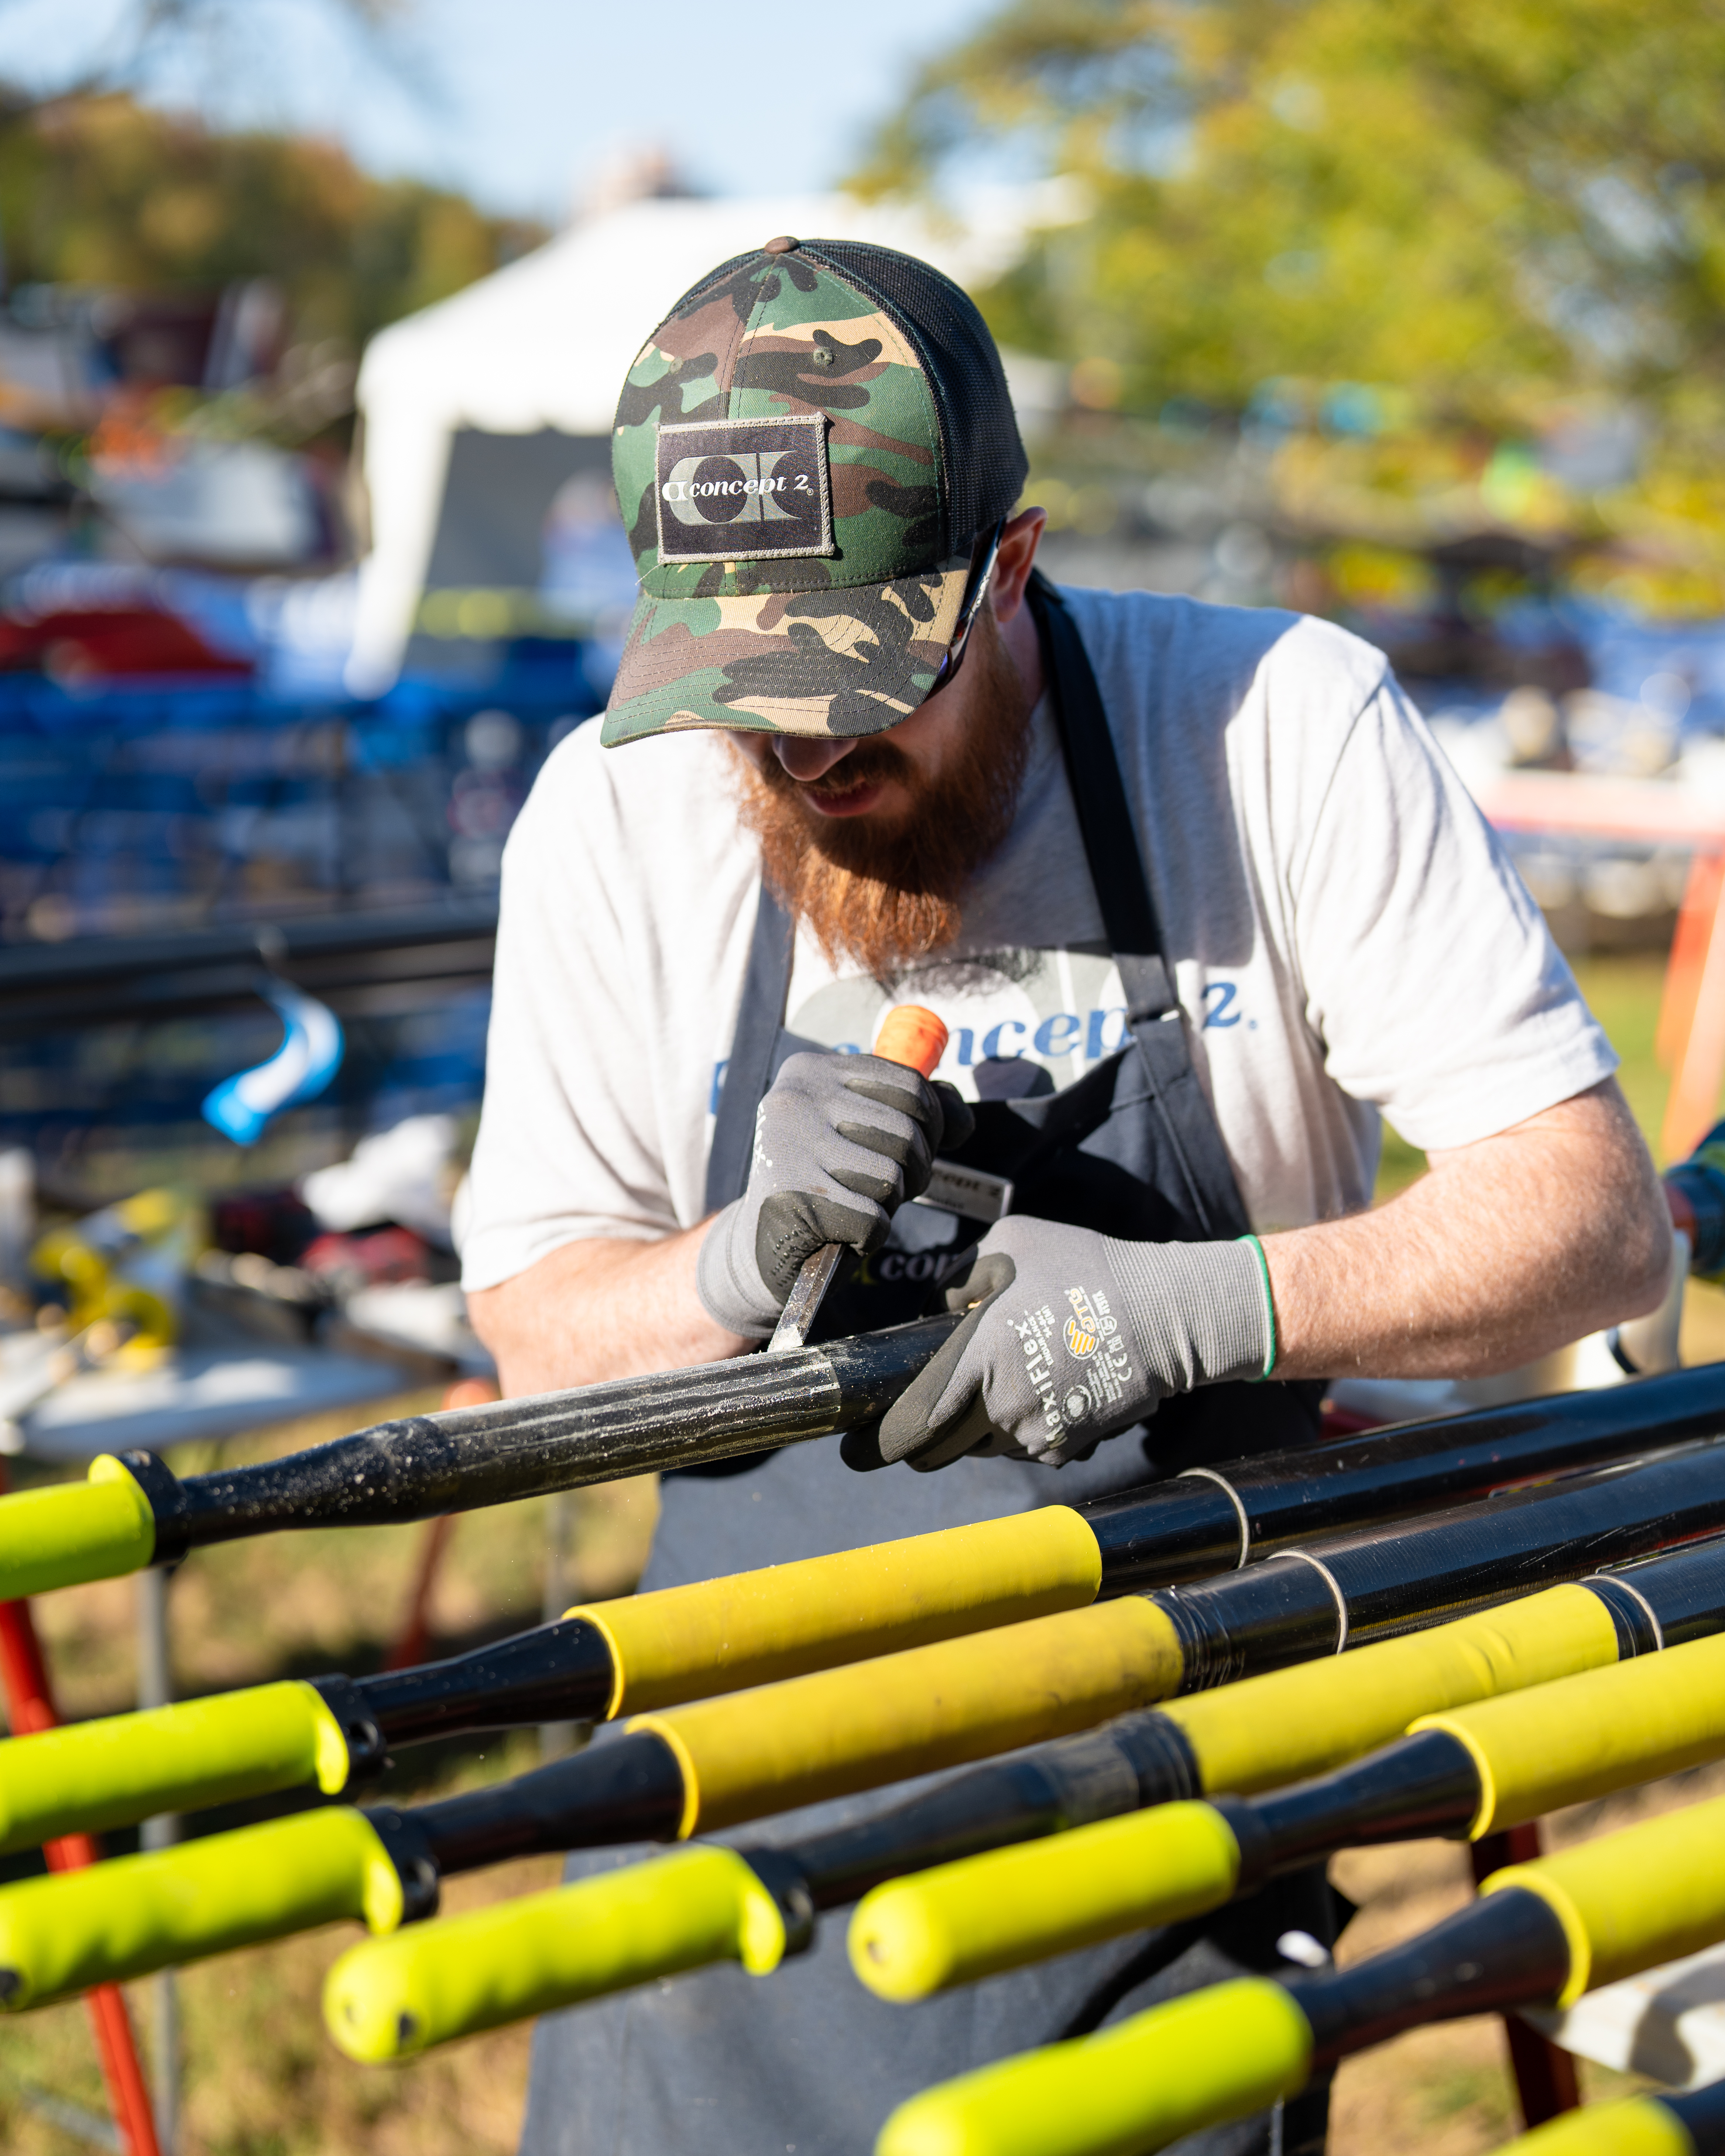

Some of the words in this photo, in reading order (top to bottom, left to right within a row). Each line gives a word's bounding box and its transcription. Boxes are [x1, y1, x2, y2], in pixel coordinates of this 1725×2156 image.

[689, 475, 787, 497] concept
[1028, 1315, 1054, 1366] ENDURANCE
[1035, 1310, 1053, 1338] 34-844
[1015, 1321, 1068, 1449] MaxiFlex
